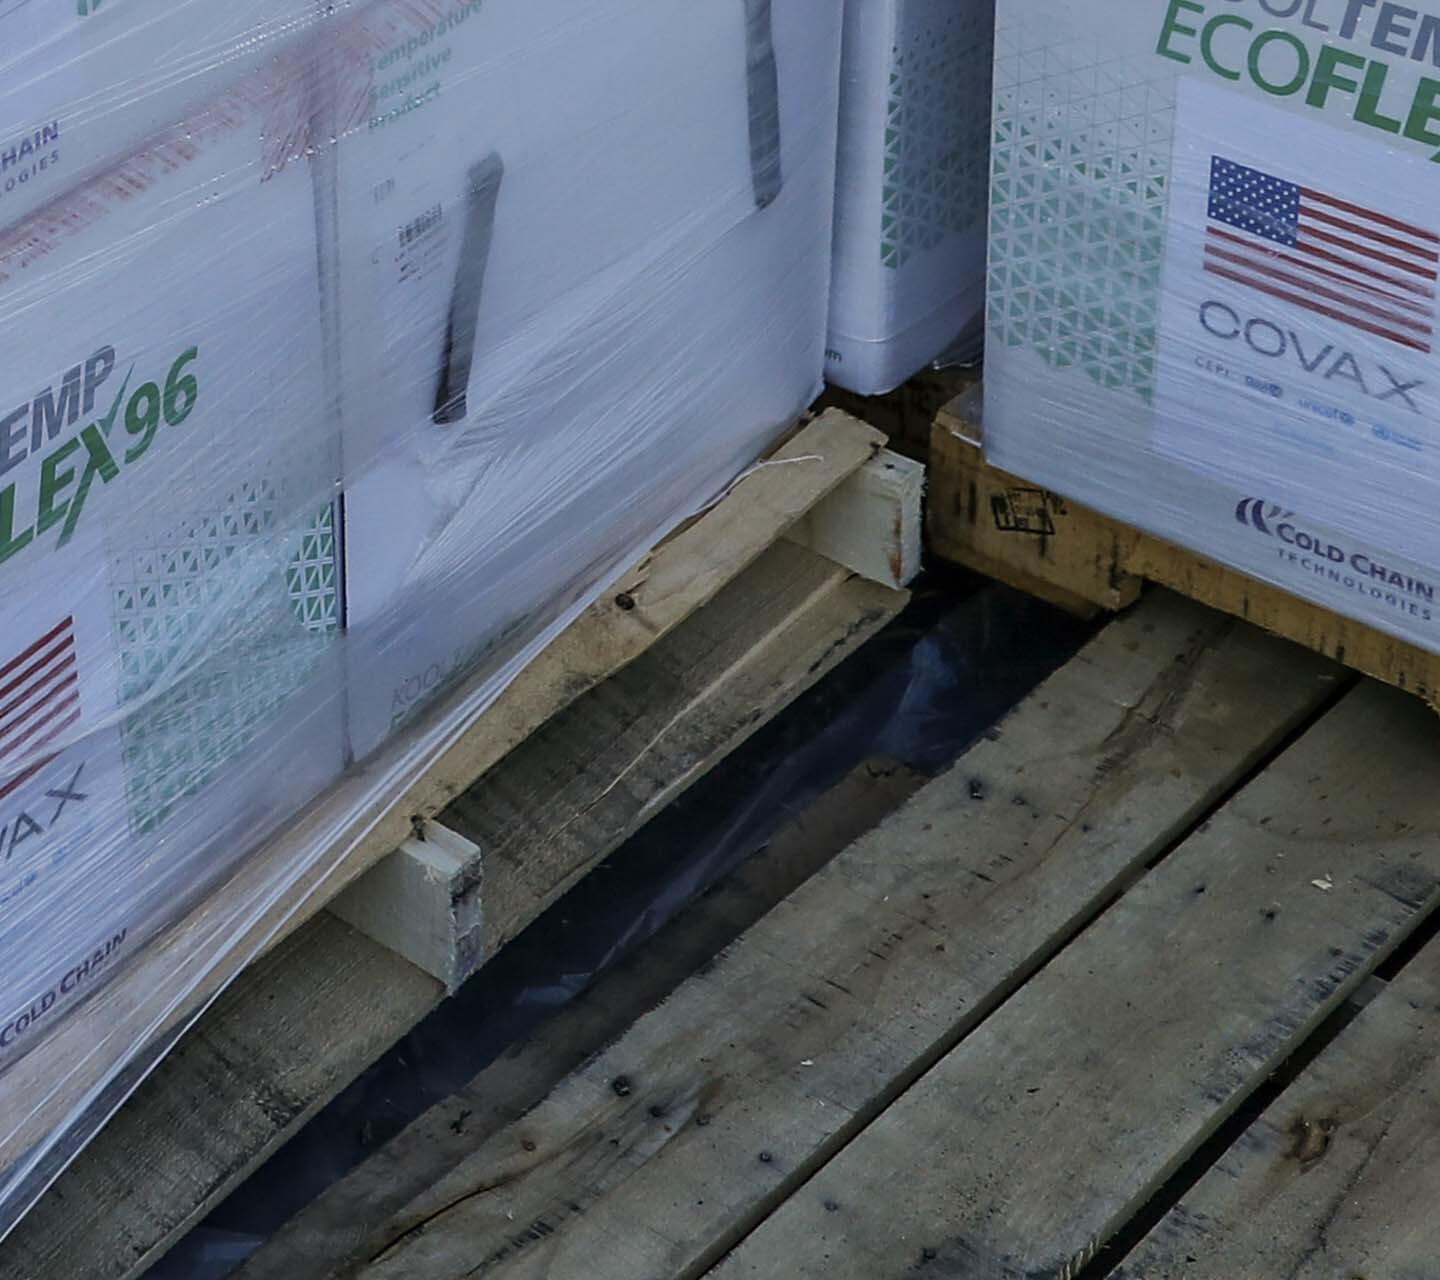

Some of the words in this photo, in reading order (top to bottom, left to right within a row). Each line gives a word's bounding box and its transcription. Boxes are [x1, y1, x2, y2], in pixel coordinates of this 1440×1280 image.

[1199, 300, 1426, 415] COVAX
[1275, 521, 1344, 567] COLD
[1350, 553, 1436, 601] CHAIN
[1276, 545, 1434, 623] TECHNOLOGIES
[59, 926, 129, 995] CHAIN
